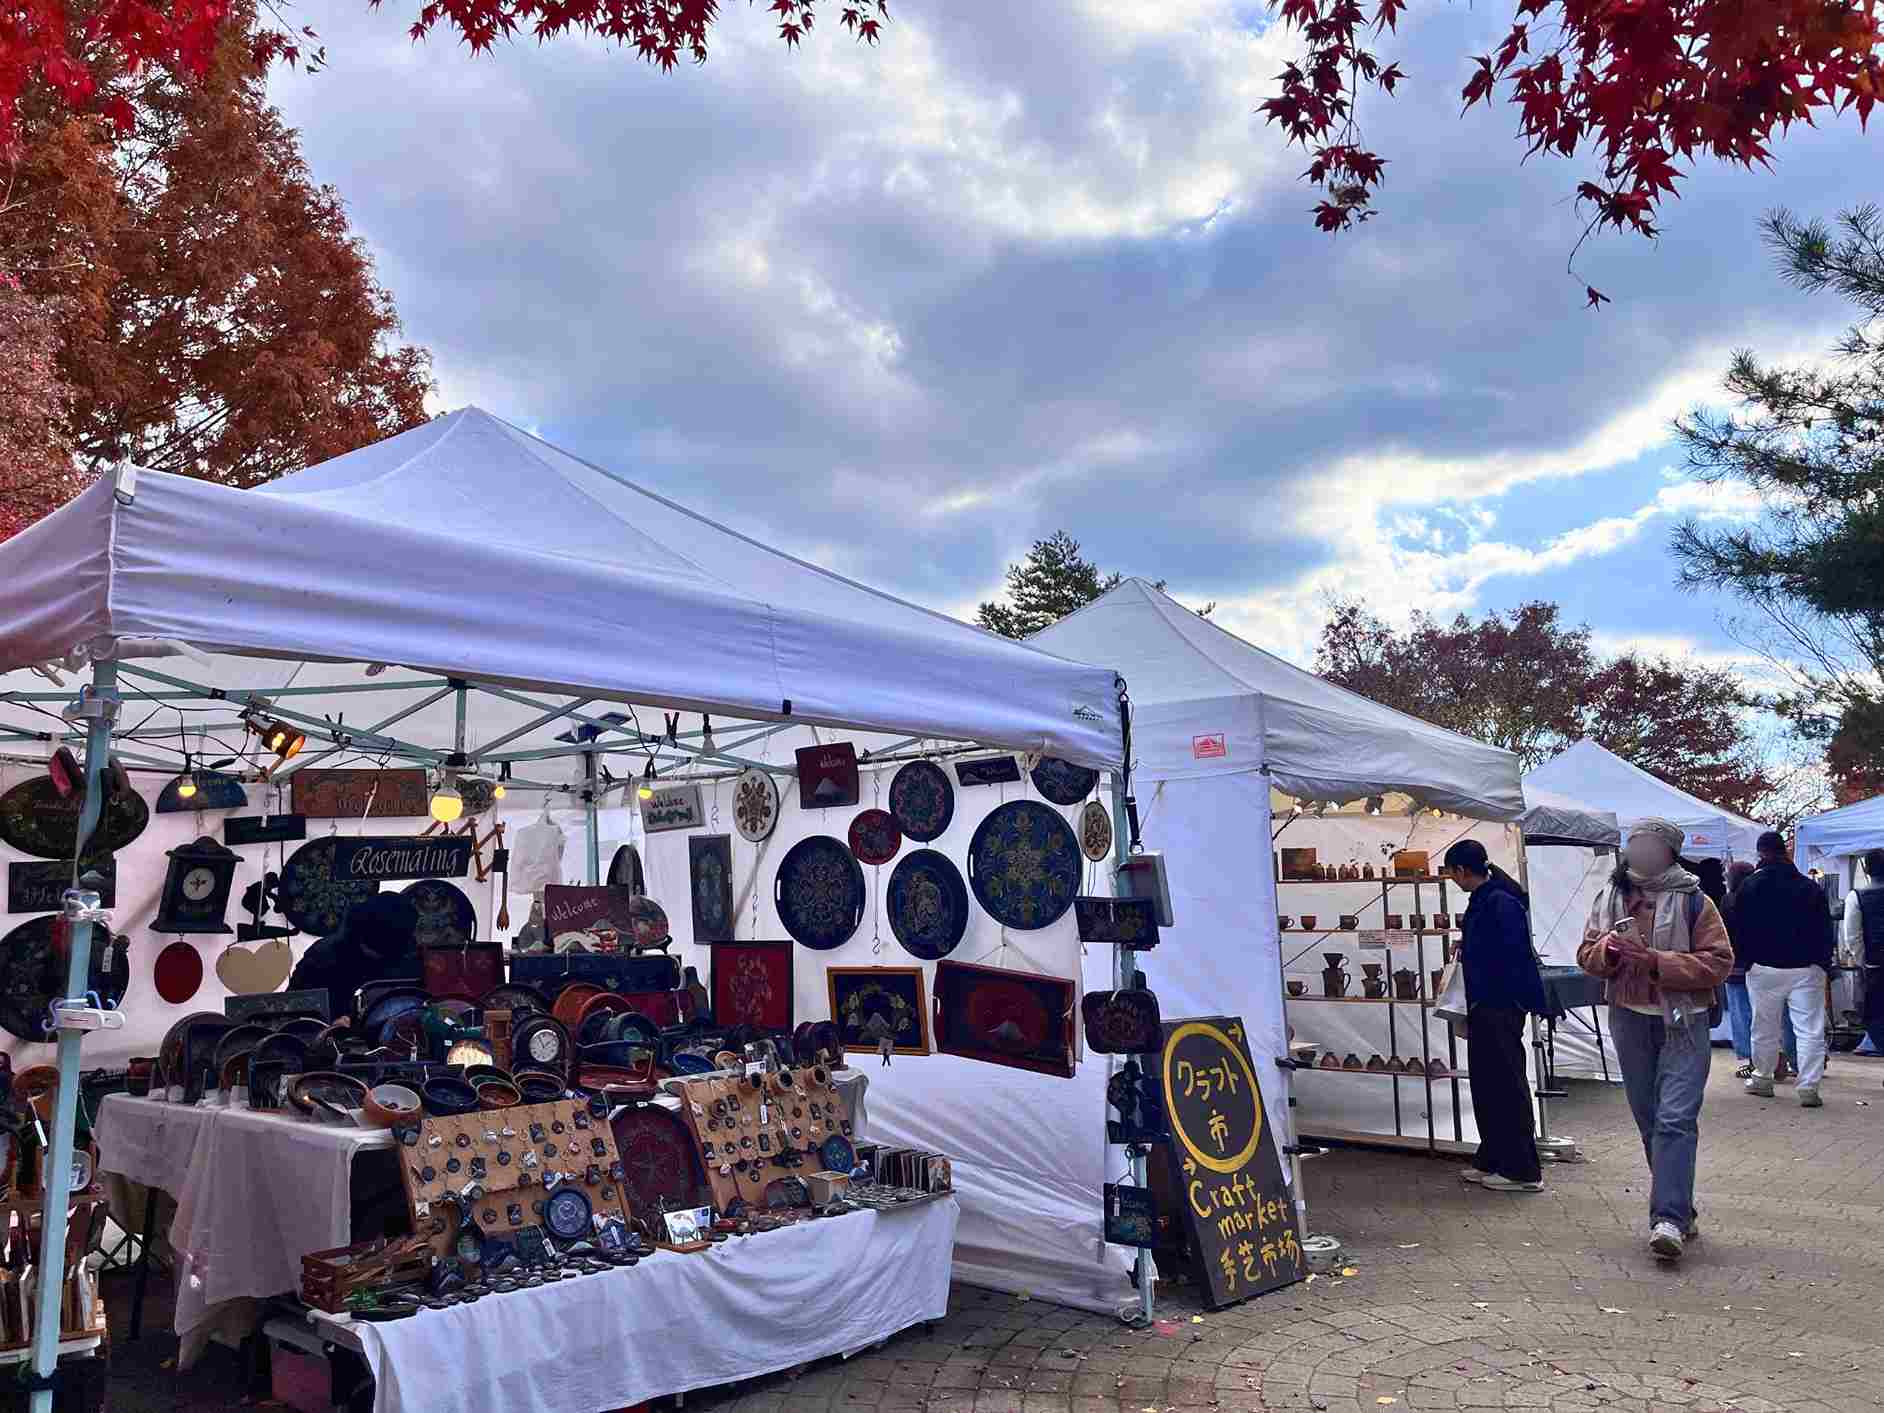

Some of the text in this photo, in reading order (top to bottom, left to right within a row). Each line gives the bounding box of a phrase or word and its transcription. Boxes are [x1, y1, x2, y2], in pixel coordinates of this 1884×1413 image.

[551, 896, 600, 921] Welcome
[1177, 1057, 1239, 1101] クラフト
[1208, 1109, 1228, 1152] 市
[1190, 1173, 1257, 1218] Craft
[1217, 1194, 1287, 1240] market
